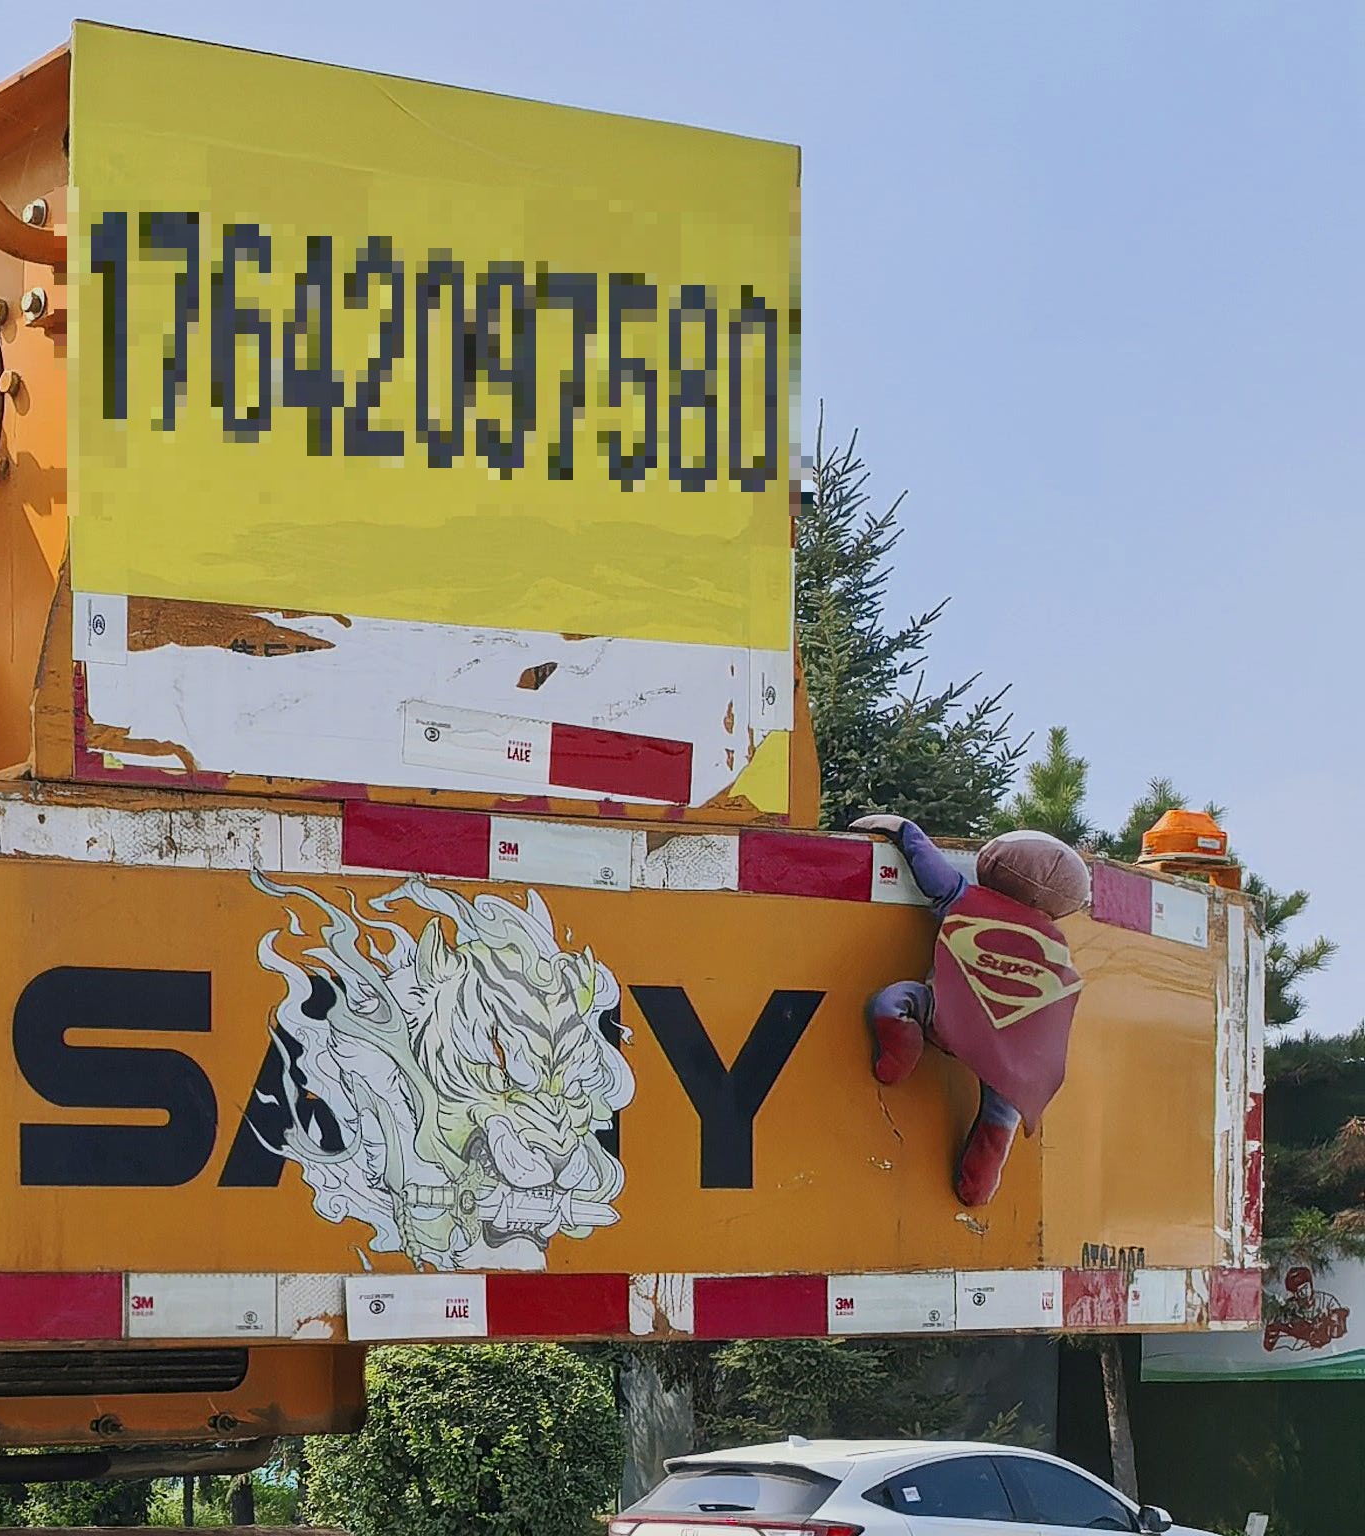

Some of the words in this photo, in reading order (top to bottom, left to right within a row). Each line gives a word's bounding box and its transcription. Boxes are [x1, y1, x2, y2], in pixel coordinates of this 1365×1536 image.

[90, 211, 778, 492] 17642097580
[498, 841, 519, 856] 3M
[879, 866, 898, 880] 3M
[975, 952, 1045, 980] Super
[131, 1296, 154, 1310] 3M
[835, 1297, 854, 1310] 3M
